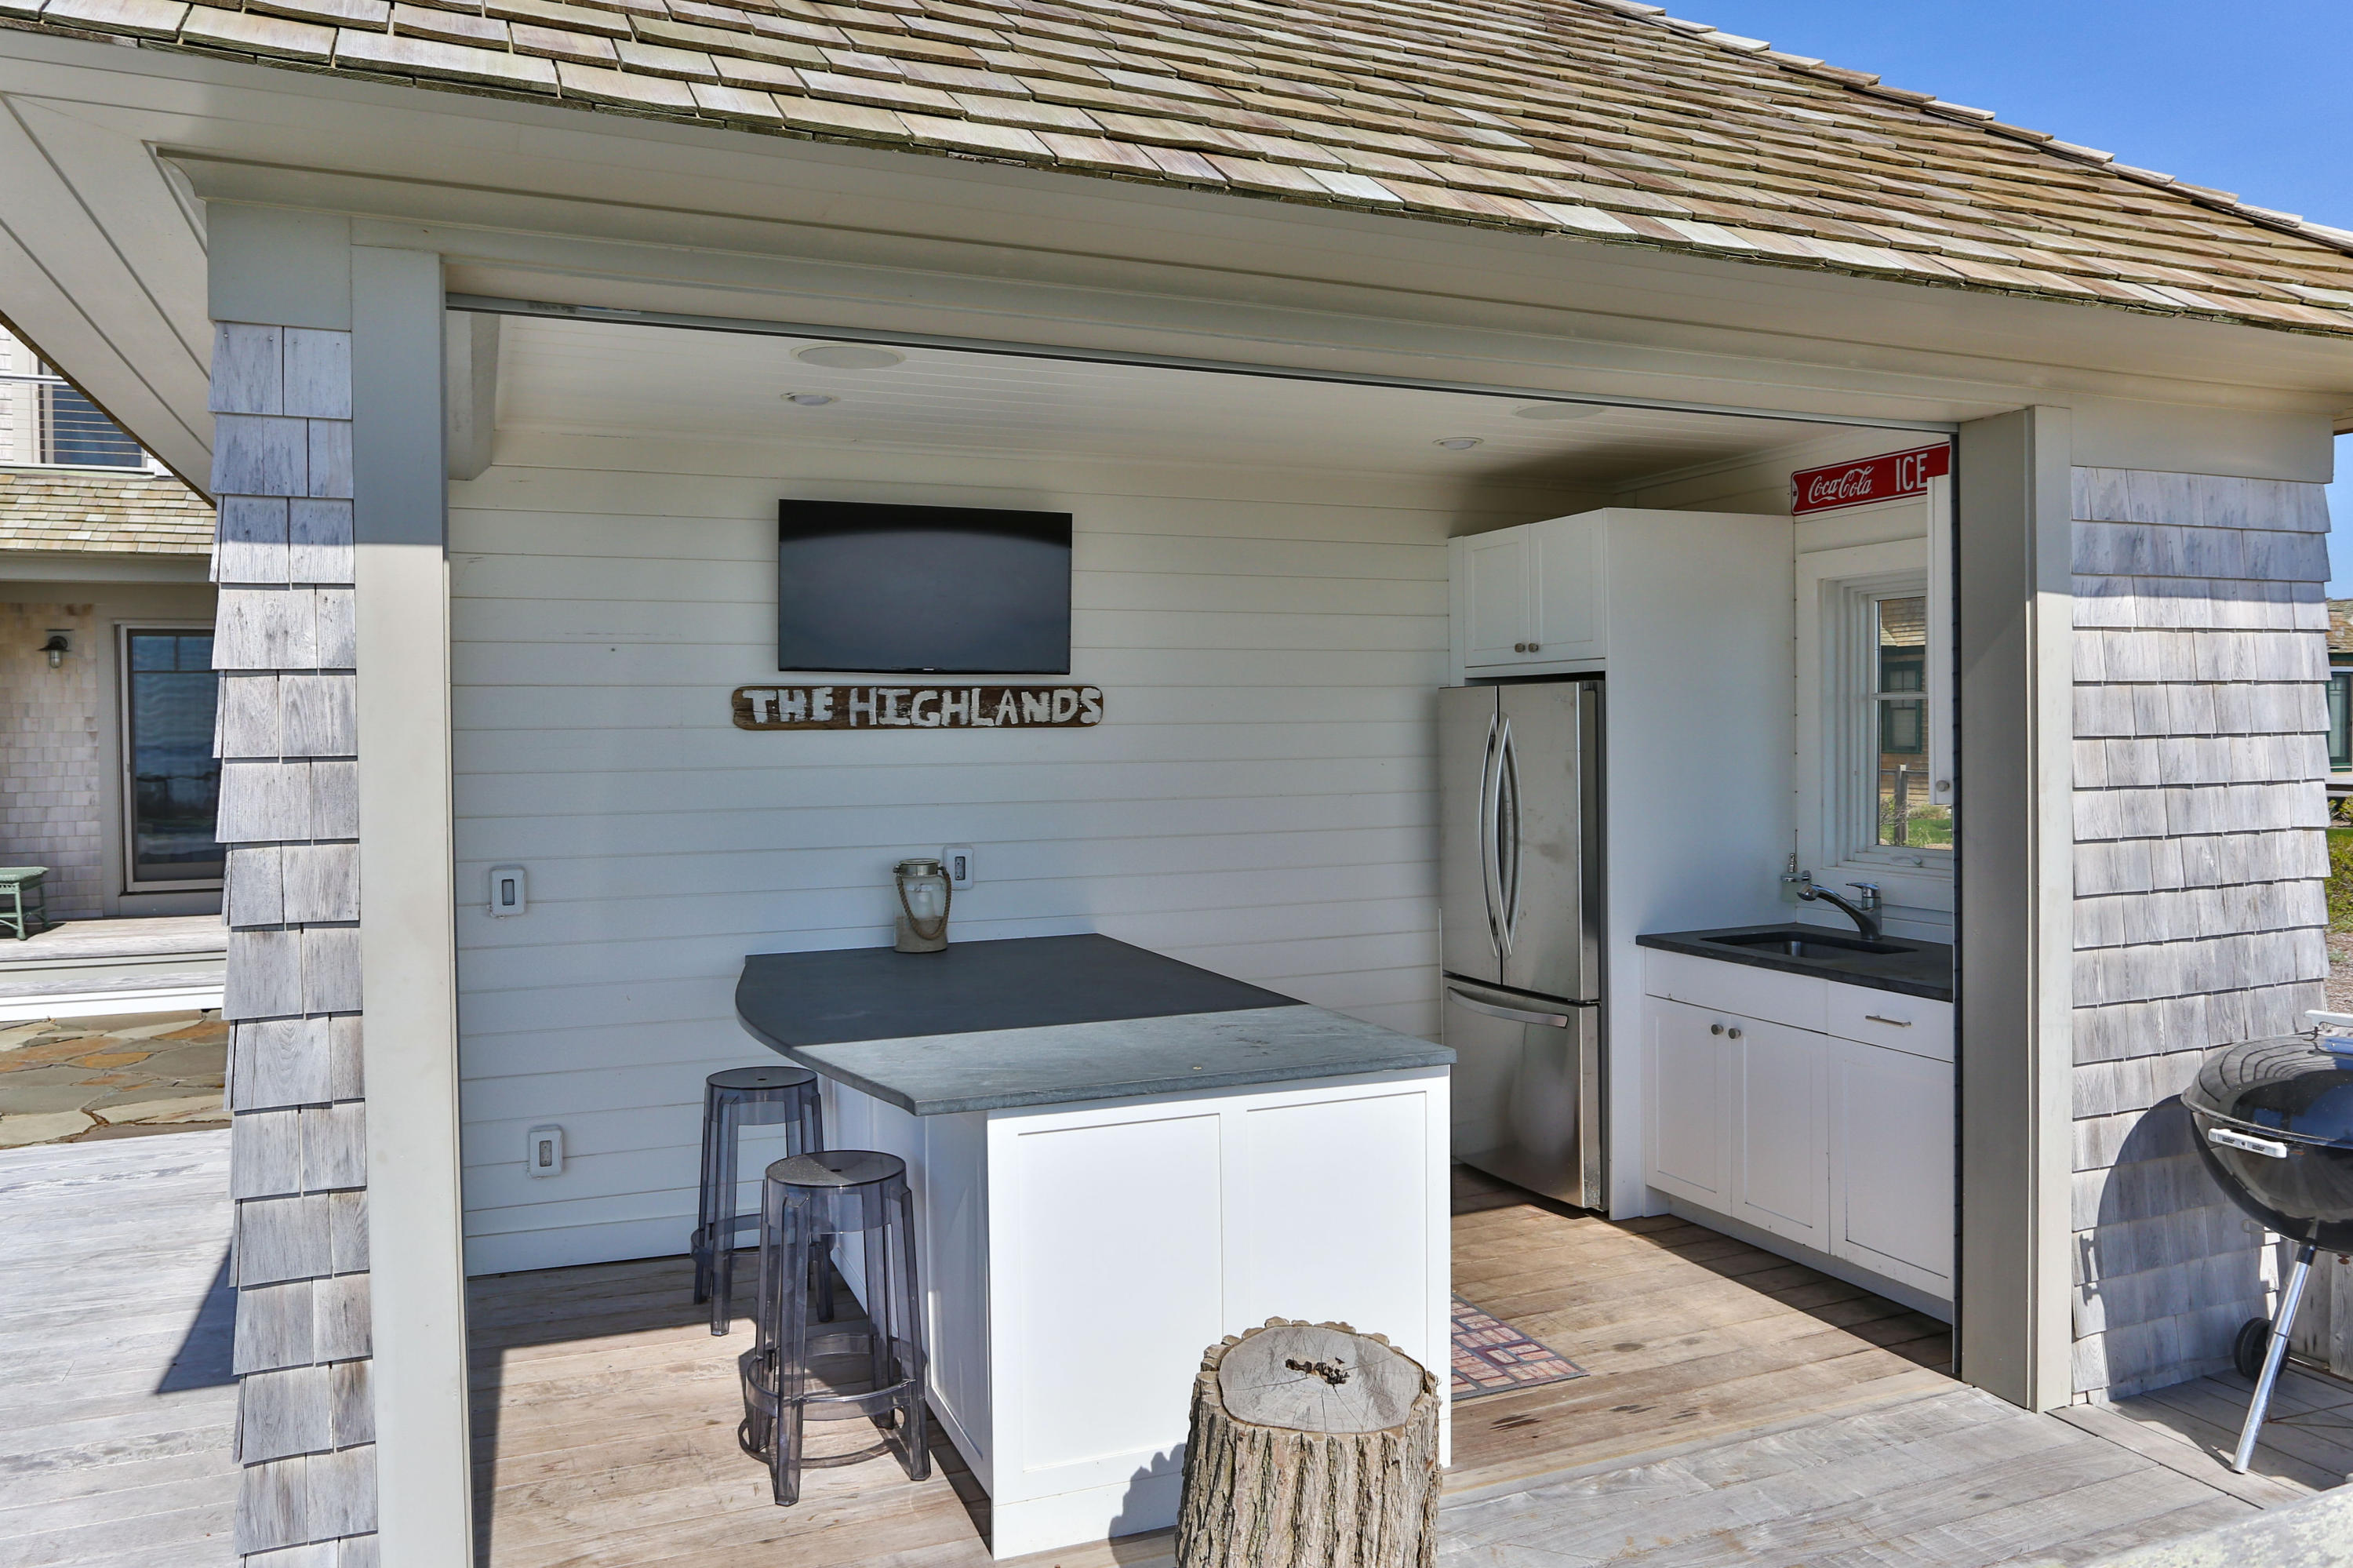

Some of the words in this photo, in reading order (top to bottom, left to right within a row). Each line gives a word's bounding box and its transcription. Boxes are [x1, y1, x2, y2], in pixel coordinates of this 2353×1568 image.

[1808, 466, 1875, 504] Coca-Cola
[1896, 453, 1928, 492] ICE
[742, 686, 833, 724] THE
[848, 686, 1103, 727] HIGHLANDS
